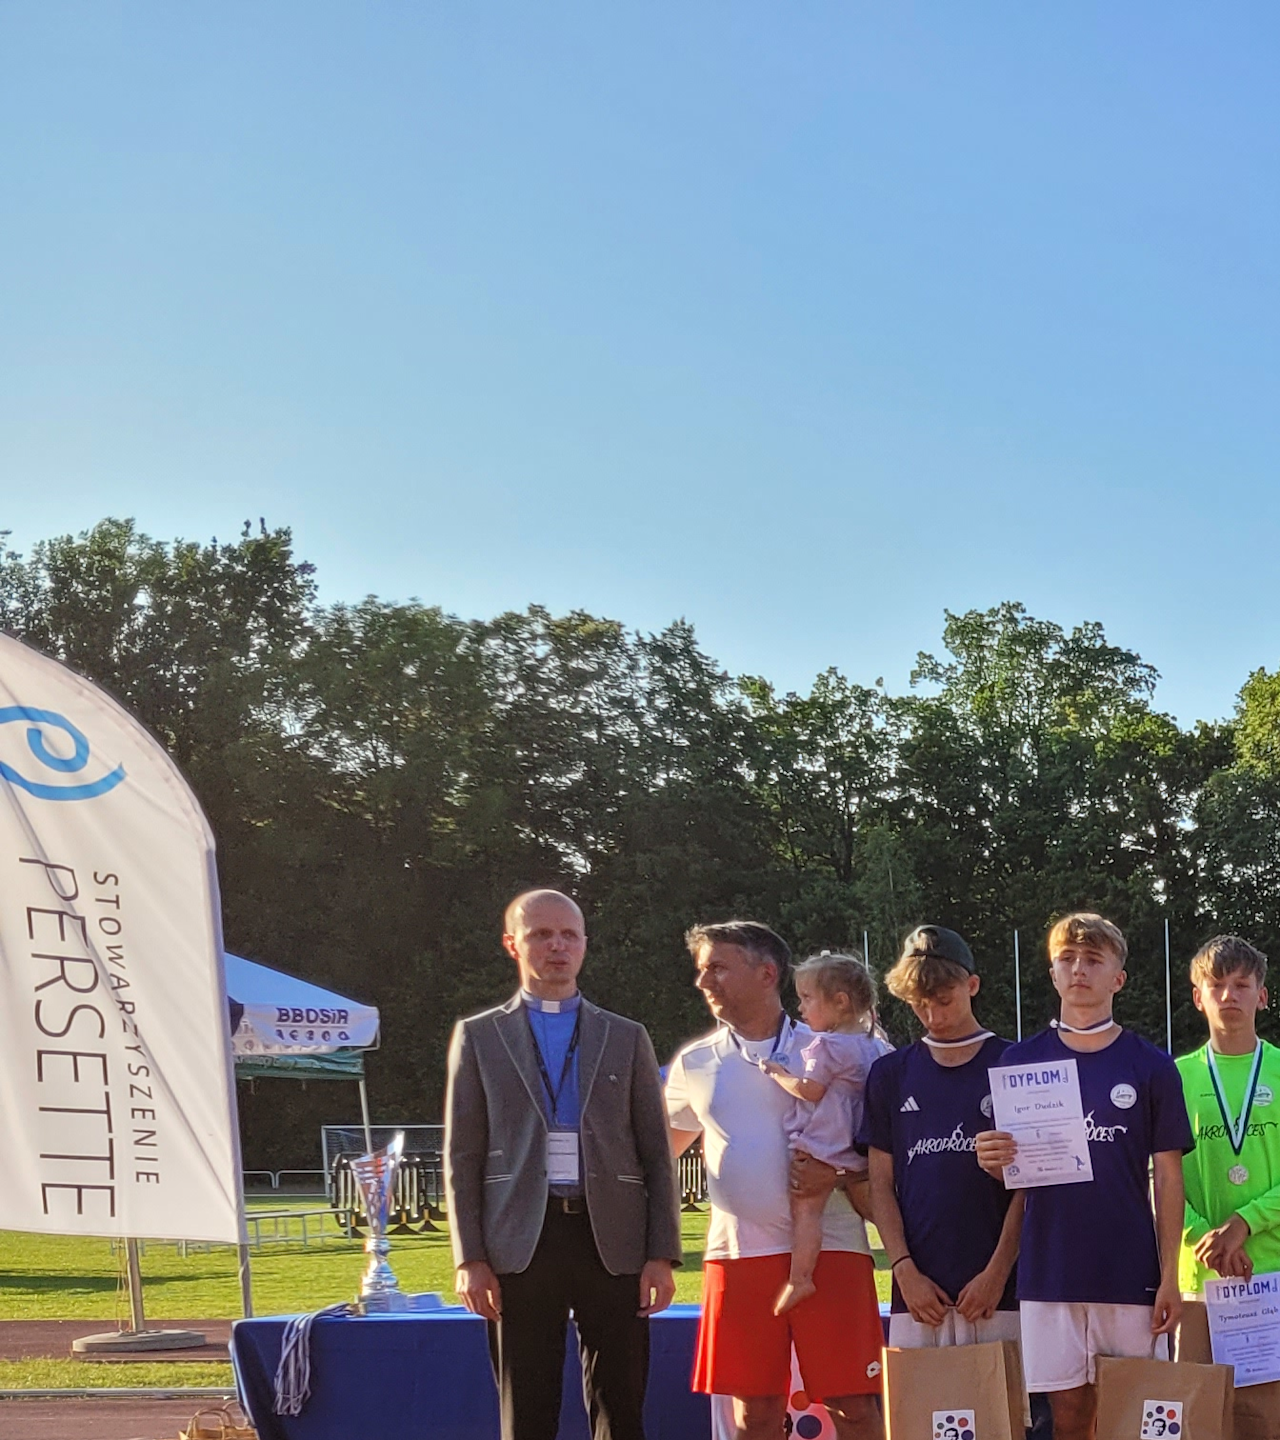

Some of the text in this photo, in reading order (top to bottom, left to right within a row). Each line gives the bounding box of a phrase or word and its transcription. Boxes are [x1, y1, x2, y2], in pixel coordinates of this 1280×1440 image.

[93, 870, 160, 1185] STOWARZYSZENIE
[18, 857, 116, 1218] PERSETTE
[1009, 1069, 1061, 1088] DYPLOM
[1014, 1100, 1064, 1114] Igor Dudzik
[1222, 1280, 1271, 1299] DYPLOM
